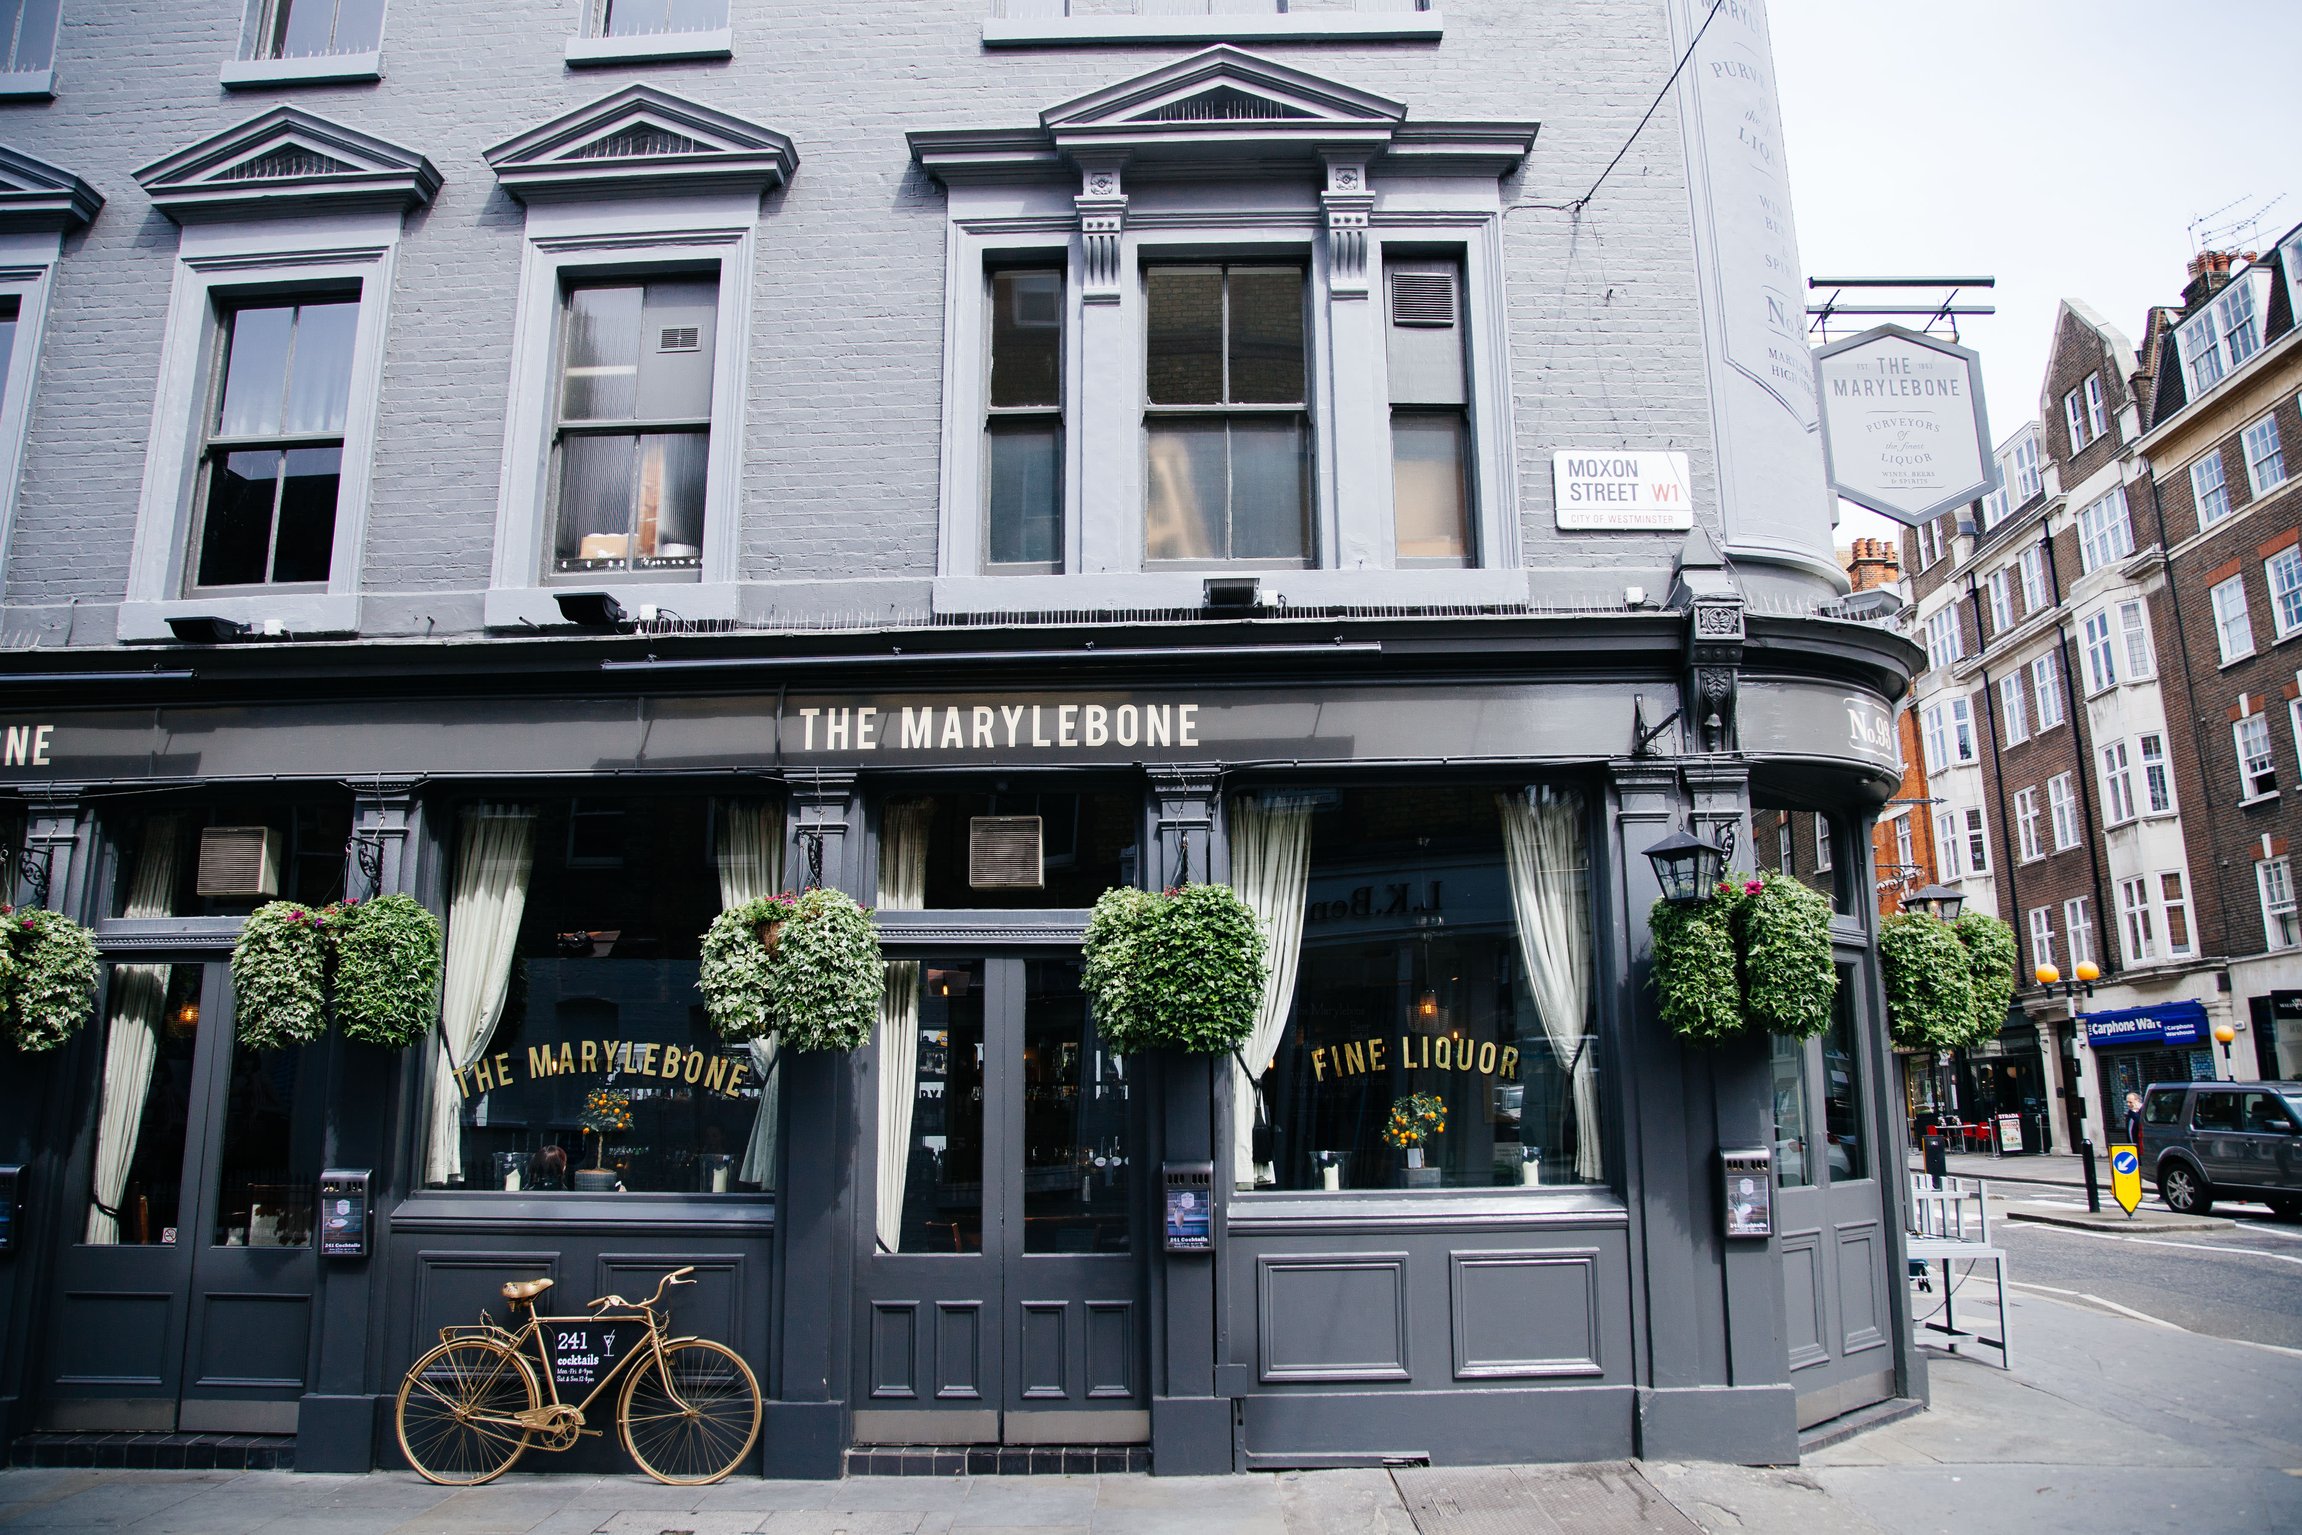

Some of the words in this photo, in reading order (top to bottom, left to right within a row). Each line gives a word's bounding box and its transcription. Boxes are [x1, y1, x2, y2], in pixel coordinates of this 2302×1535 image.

[1877, 357, 1912, 375] THE
[1834, 379, 1961, 397] MARYLEBONE
[1866, 417, 1941, 433] PURVEYORS
[1899, 441, 1925, 451] finest
[1568, 459, 1639, 478] MOXON
[1881, 453, 1933, 467] LIQUOR
[1570, 483, 1639, 501] STREET
[1652, 484, 1679, 502] W1
[1571, 514, 1590, 524] CITY
[1593, 514, 1605, 524] OF
[1608, 514, 1674, 524] WESTMINSTER
[799, 707, 877, 751] THE
[901, 704, 1199, 750] MARYLEBONE
[0, 724, 55, 767] NE
[2092, 1020, 2136, 1036] Carphone
[2167, 1023, 2195, 1031] Carphone
[1310, 1038, 1386, 1083] FINE
[1402, 1036, 1521, 1080] LIQUOR
[453, 1052, 514, 1100] THE
[528, 1040, 751, 1099] MARYLEBONE
[557, 1332, 588, 1350] 241
[557, 1354, 600, 1366] cocktails
